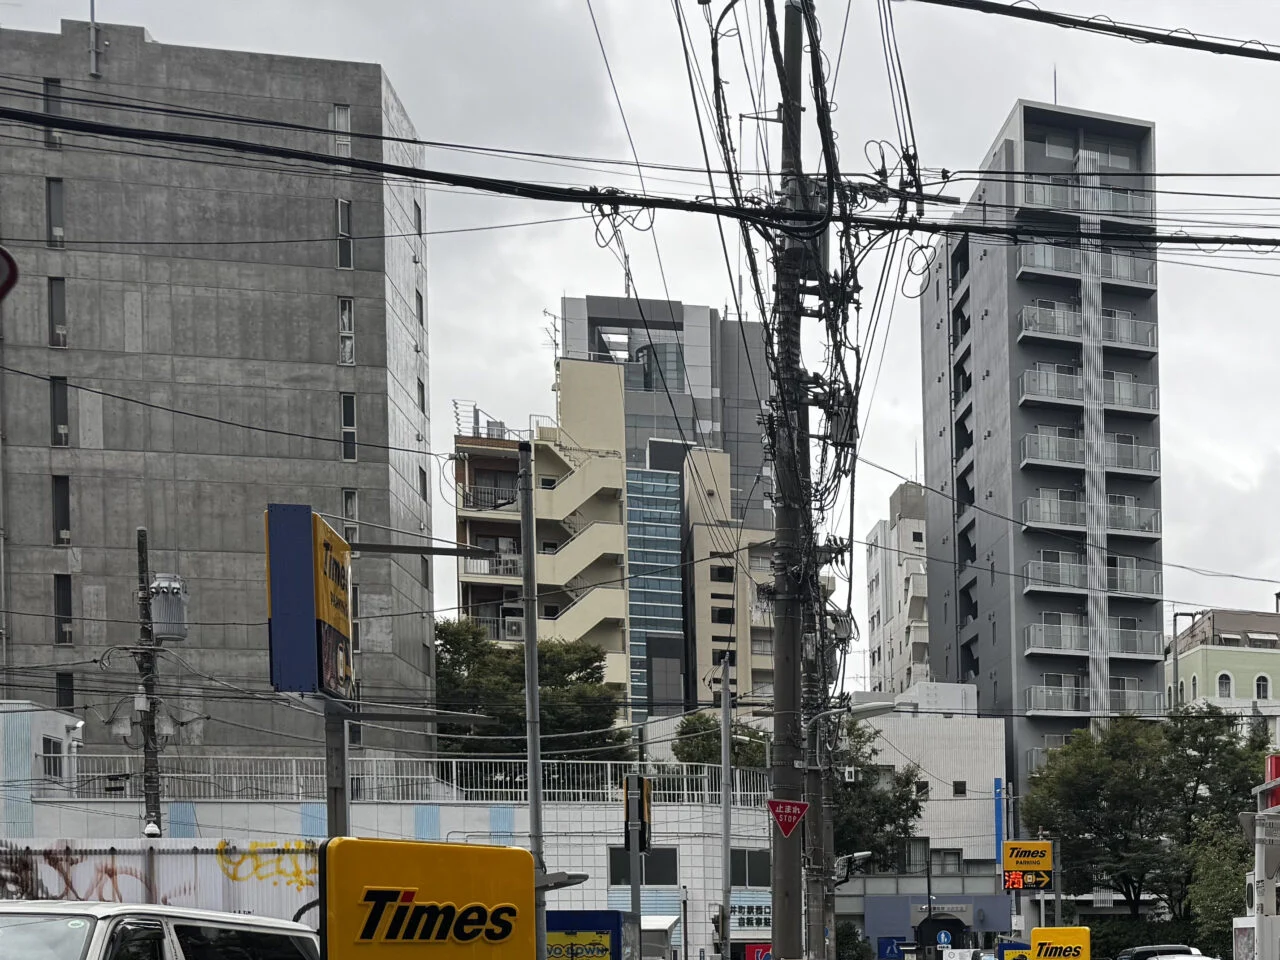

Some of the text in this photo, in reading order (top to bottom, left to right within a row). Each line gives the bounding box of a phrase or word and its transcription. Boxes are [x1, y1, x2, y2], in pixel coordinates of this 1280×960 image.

[775, 806, 800, 814] 止まれ
[779, 815, 797, 823] STOP
[1009, 847, 1047, 858] Times
[357, 888, 518, 942] Times
[1037, 942, 1082, 957] Times
